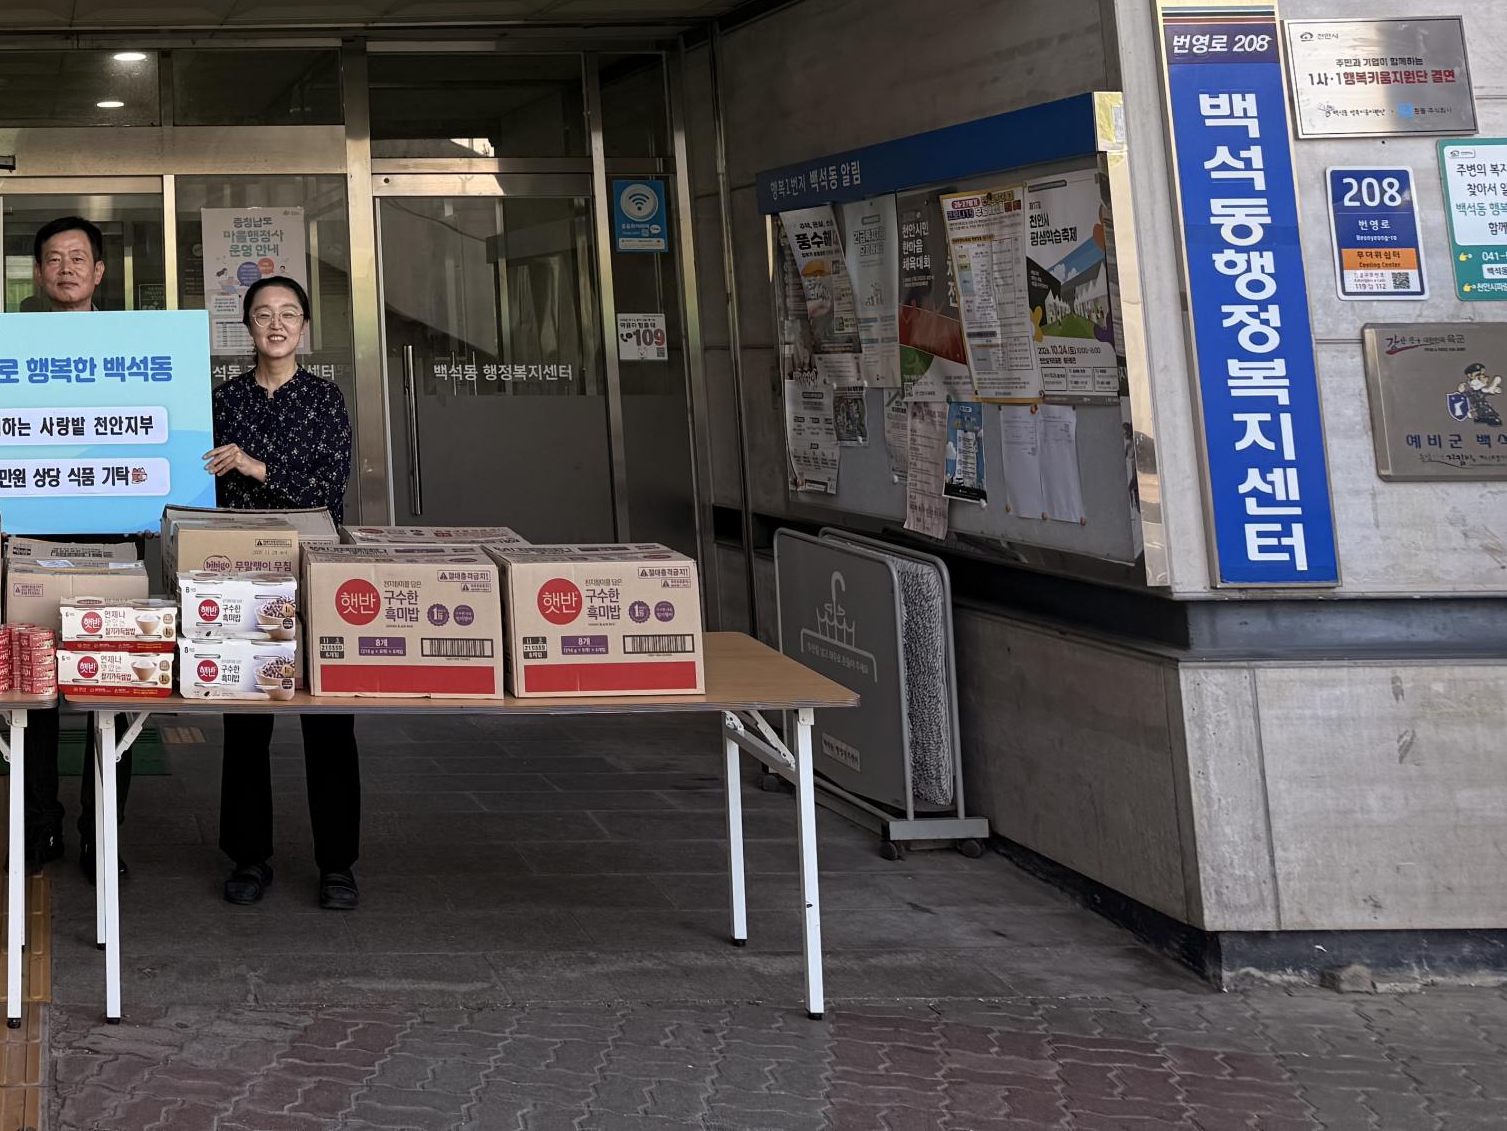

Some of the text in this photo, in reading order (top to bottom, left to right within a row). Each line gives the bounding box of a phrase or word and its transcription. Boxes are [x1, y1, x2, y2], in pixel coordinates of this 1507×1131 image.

[1172, 34, 1270, 54] 번영로 208
[809, 166, 838, 192] 백석동
[841, 160, 861, 188] 알림
[1456, 163, 1487, 177] 주변의
[1342, 177, 1402, 207] 208
[1467, 183, 1497, 196] 찾아서
[1456, 202, 1487, 216] 백석동
[1029, 212, 1050, 228] 천안시
[1358, 220, 1391, 231] 번영로
[223, 229, 284, 243] 마을행정사
[902, 222, 929, 238] 천안시민
[1031, 226, 1077, 246] 평생학습축제
[229, 244, 279, 257] 운영 안내
[635, 328, 666, 347] 109
[1198, 92, 1309, 572] 백석동행정복지센터
[25, 356, 97, 384] 행복한
[103, 355, 173, 383] 백석동
[212, 364, 242, 381] 석동
[433, 364, 573, 381] 백석동 행정복지센터
[39, 416, 86, 436] 사랑밭
[93, 415, 154, 436] 천안지부
[1406, 433, 1463, 449] 예비군
[33, 468, 61, 487] 상당
[67, 467, 95, 486] 식품
[101, 466, 130, 486] 기탁
[206, 560, 292, 571] bibigo 무말랭이 무침
[341, 592, 376, 614] 햇반
[383, 590, 419, 606] 구수한
[543, 592, 578, 614] 햇반
[585, 588, 620, 603] 구수한
[104, 610, 125, 618] 언제나
[201, 606, 218, 617] 햇반
[222, 604, 241, 613] 구수한
[385, 607, 420, 622] 흑미밥
[587, 605, 621, 620] 흑미밥
[84, 618, 102, 629] 햇반
[222, 614, 241, 623] 흑미밥
[100, 655, 122, 664] 언제나
[80, 662, 97, 673] 햇반
[199, 666, 216, 676] 햇반
[221, 665, 240, 674] 구수한
[221, 674, 240, 683] 흑미밥
